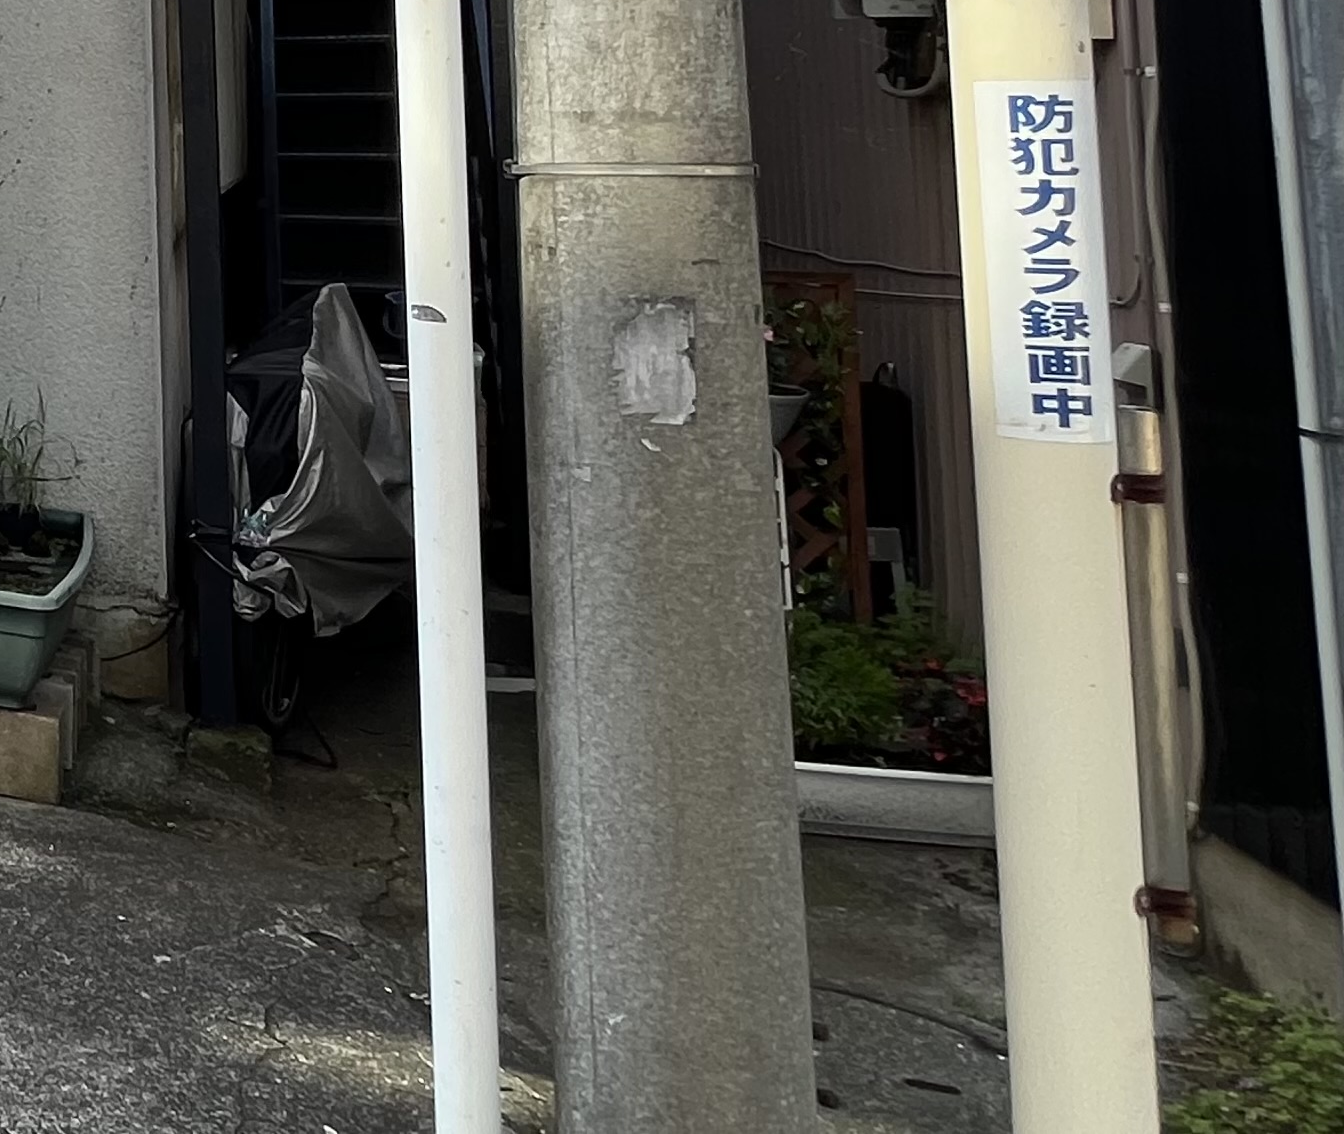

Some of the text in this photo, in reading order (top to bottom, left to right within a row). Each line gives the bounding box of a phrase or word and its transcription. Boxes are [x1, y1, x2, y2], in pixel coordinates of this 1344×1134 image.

[1007, 94, 1094, 430] 防犯カメラ録画中
